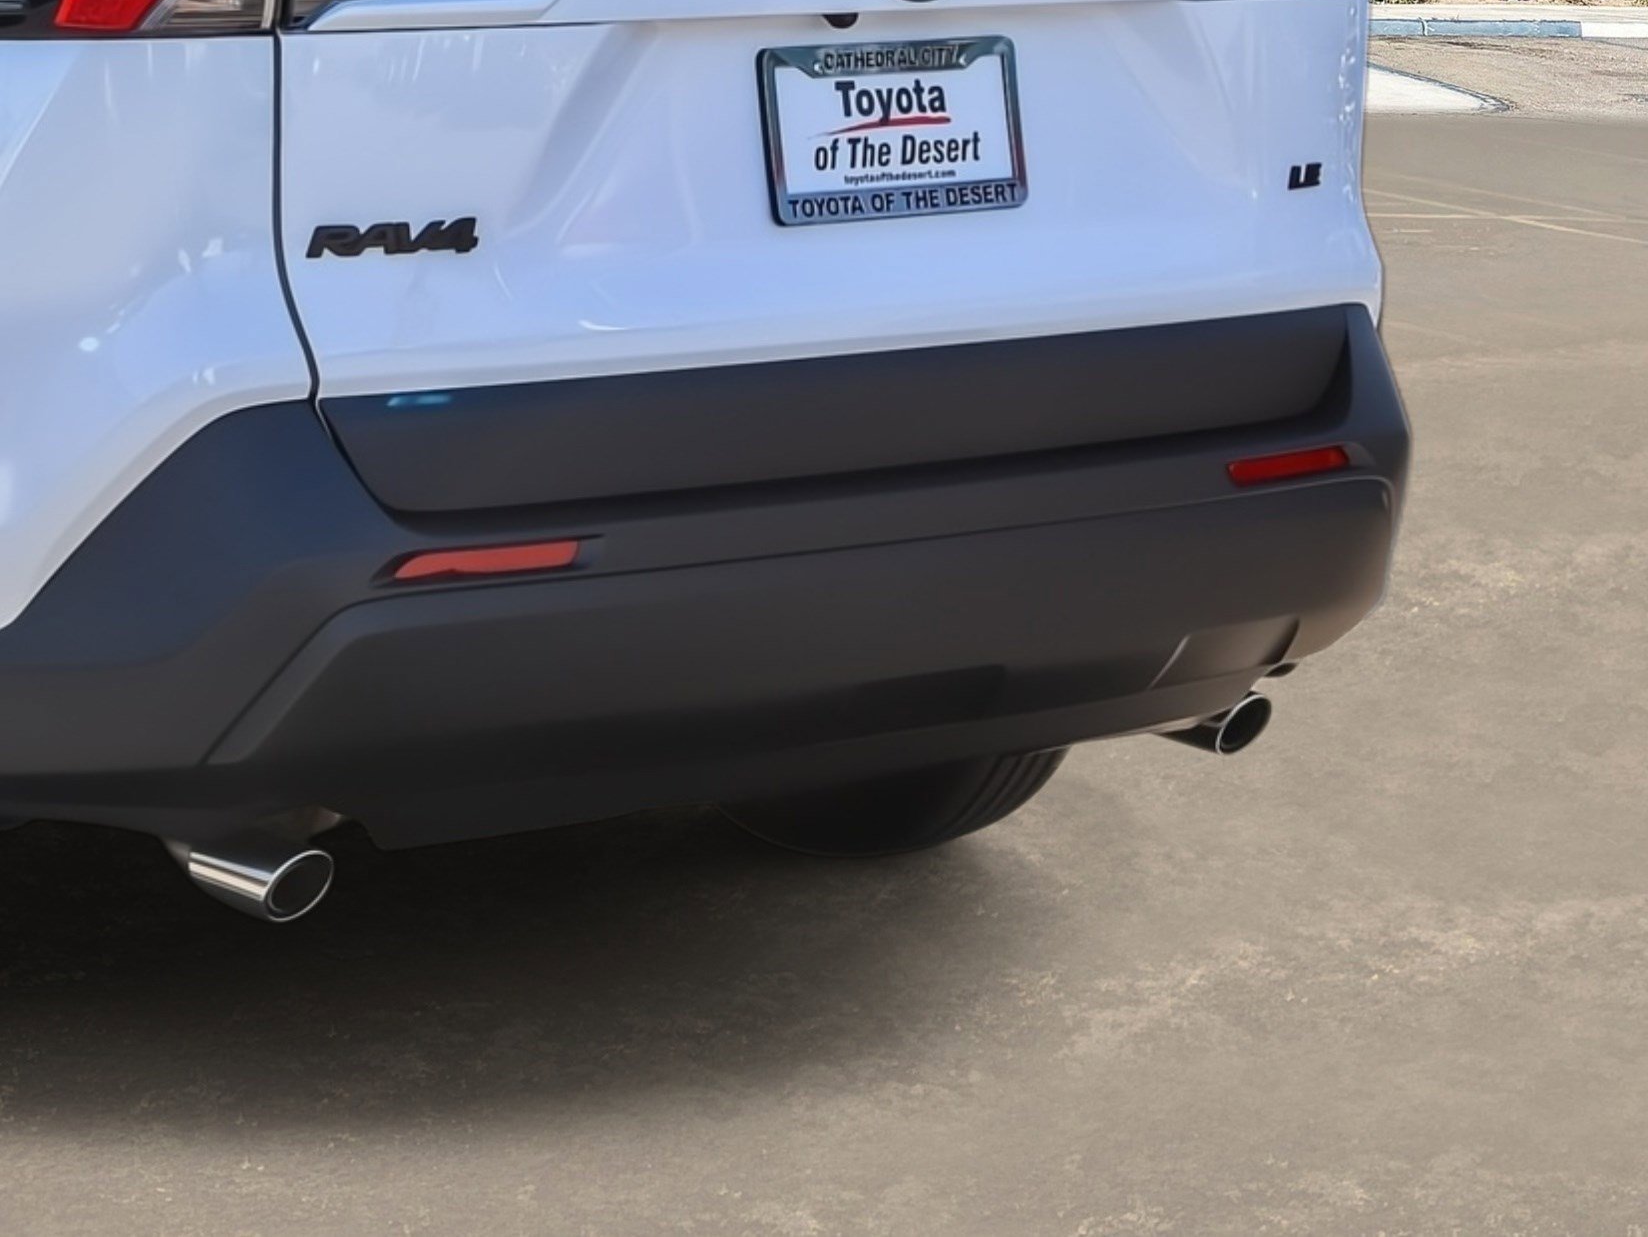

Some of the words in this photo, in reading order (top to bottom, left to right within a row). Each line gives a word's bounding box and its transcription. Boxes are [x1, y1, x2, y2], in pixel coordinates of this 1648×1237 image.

[824, 46, 919, 70] CATHEDRAL
[920, 45, 958, 66] CITY
[835, 79, 947, 122] Toyota
[815, 138, 839, 171] of
[847, 136, 891, 168] The
[901, 131, 980, 165] Desert
[1288, 163, 1322, 190] LE
[789, 195, 865, 218] TOYOTA
[871, 193, 895, 212] OF
[904, 189, 940, 209] THE
[946, 182, 1017, 206] DESERT
[306, 217, 478, 258] RAV4
